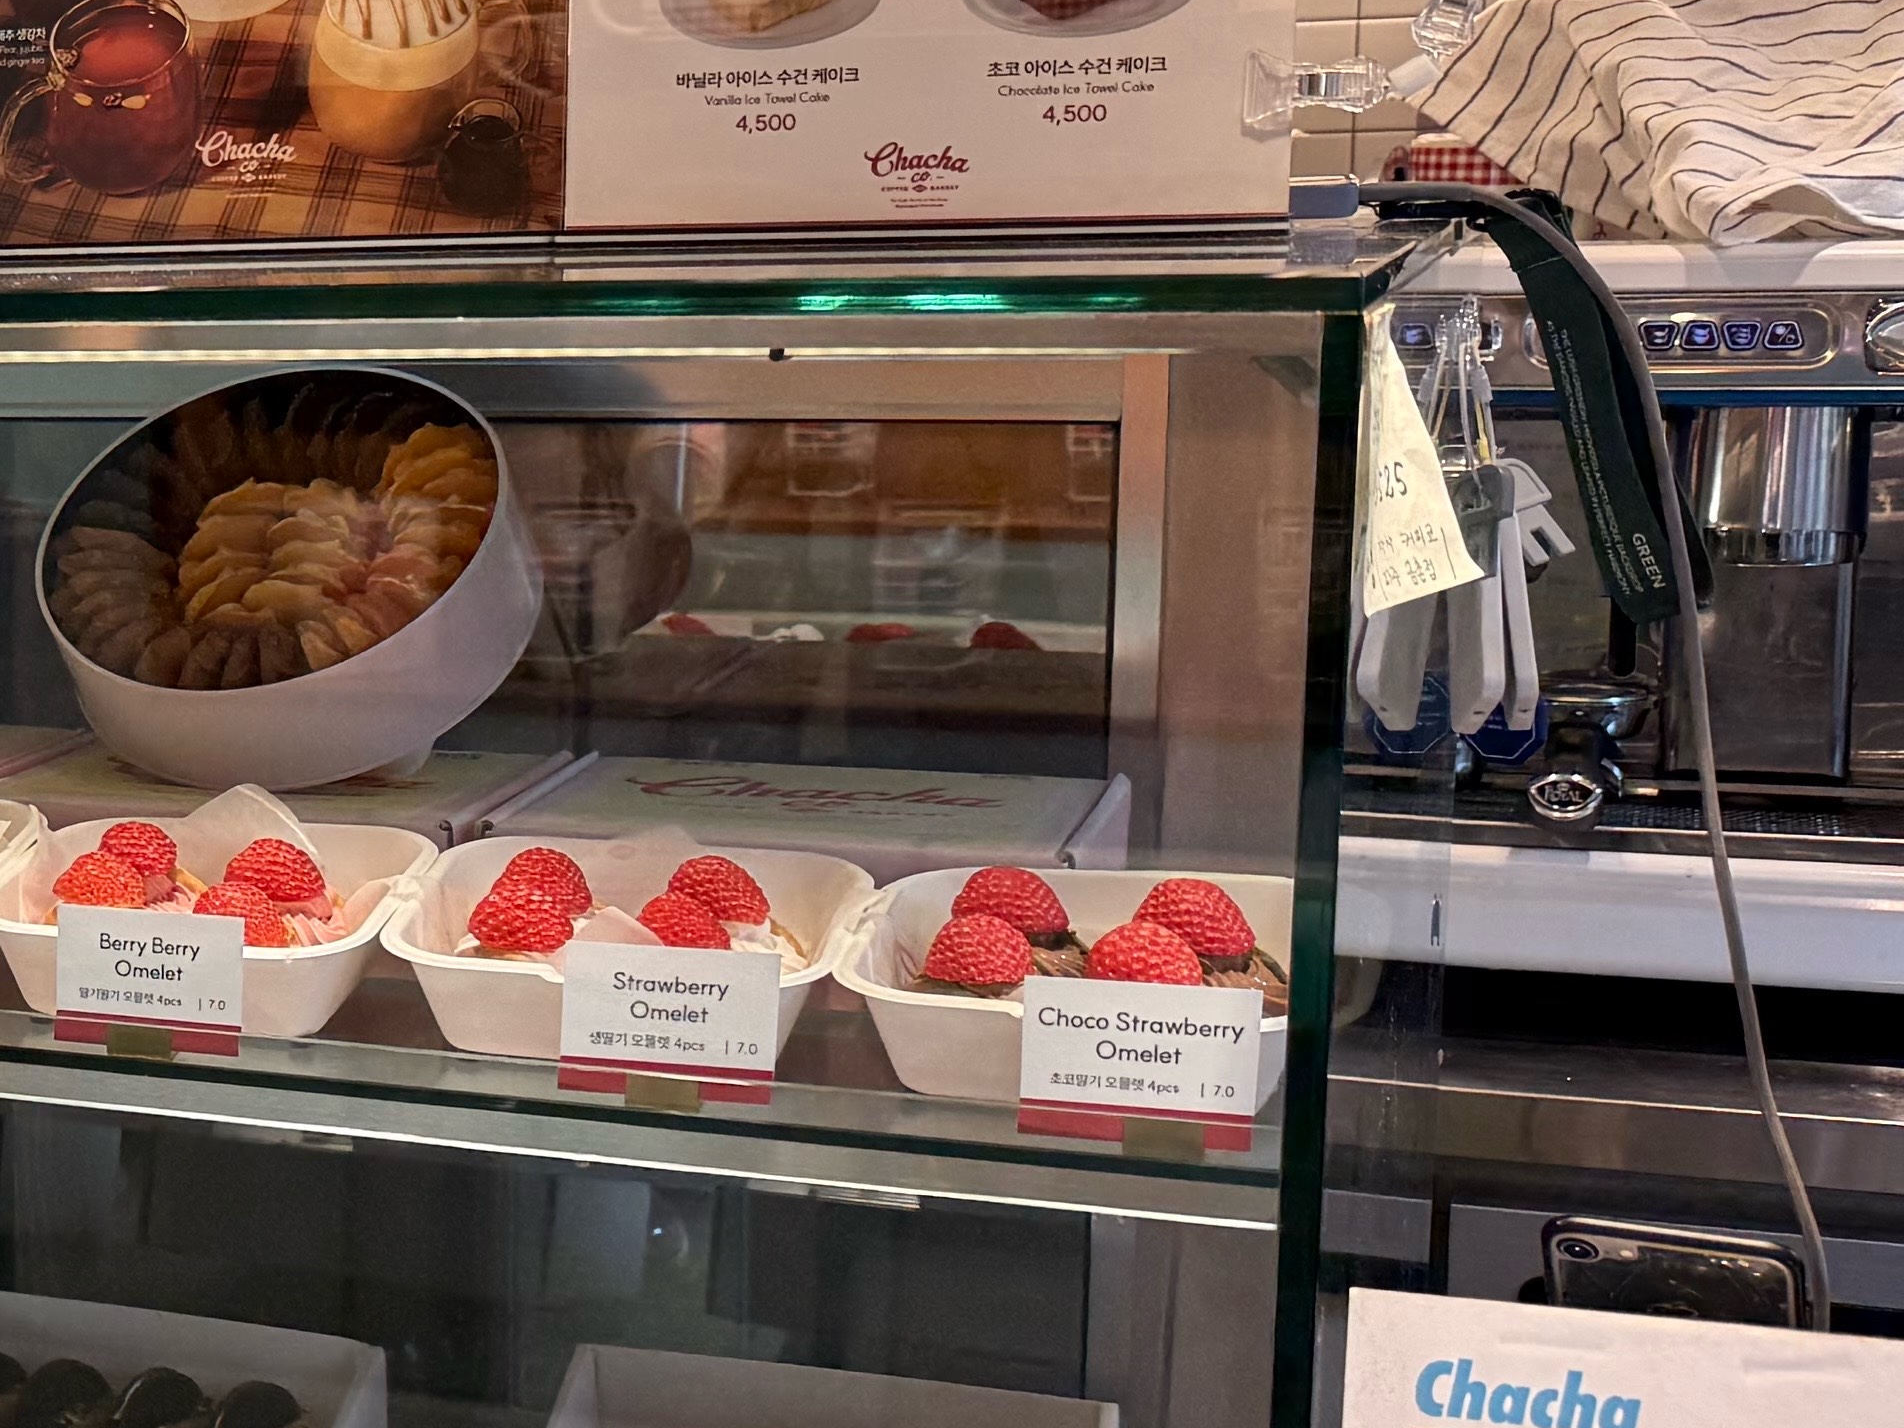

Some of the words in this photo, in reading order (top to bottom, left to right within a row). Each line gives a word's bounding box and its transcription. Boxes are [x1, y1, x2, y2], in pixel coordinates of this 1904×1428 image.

[987, 61, 1021, 79] 초코
[1023, 58, 1075, 78] 아이스
[1078, 57, 1113, 76] 수건
[1116, 55, 1168, 73] 케이크
[736, 113, 797, 135] 4,500
[1042, 104, 1108, 126] 4,500
[195, 130, 296, 166] Chacha
[864, 142, 970, 177] Chacha
[1632, 532, 1666, 589] GREEN
[100, 933, 146, 956] Berry
[152, 937, 200, 961] Berry
[115, 960, 183, 981] Omelet
[613, 972, 729, 1002] Strawberry
[629, 1001, 709, 1024] Omelet
[1038, 1007, 1110, 1033] Choco
[1117, 1011, 1245, 1044] Strawberry
[1095, 1040, 1183, 1065] Omelet
